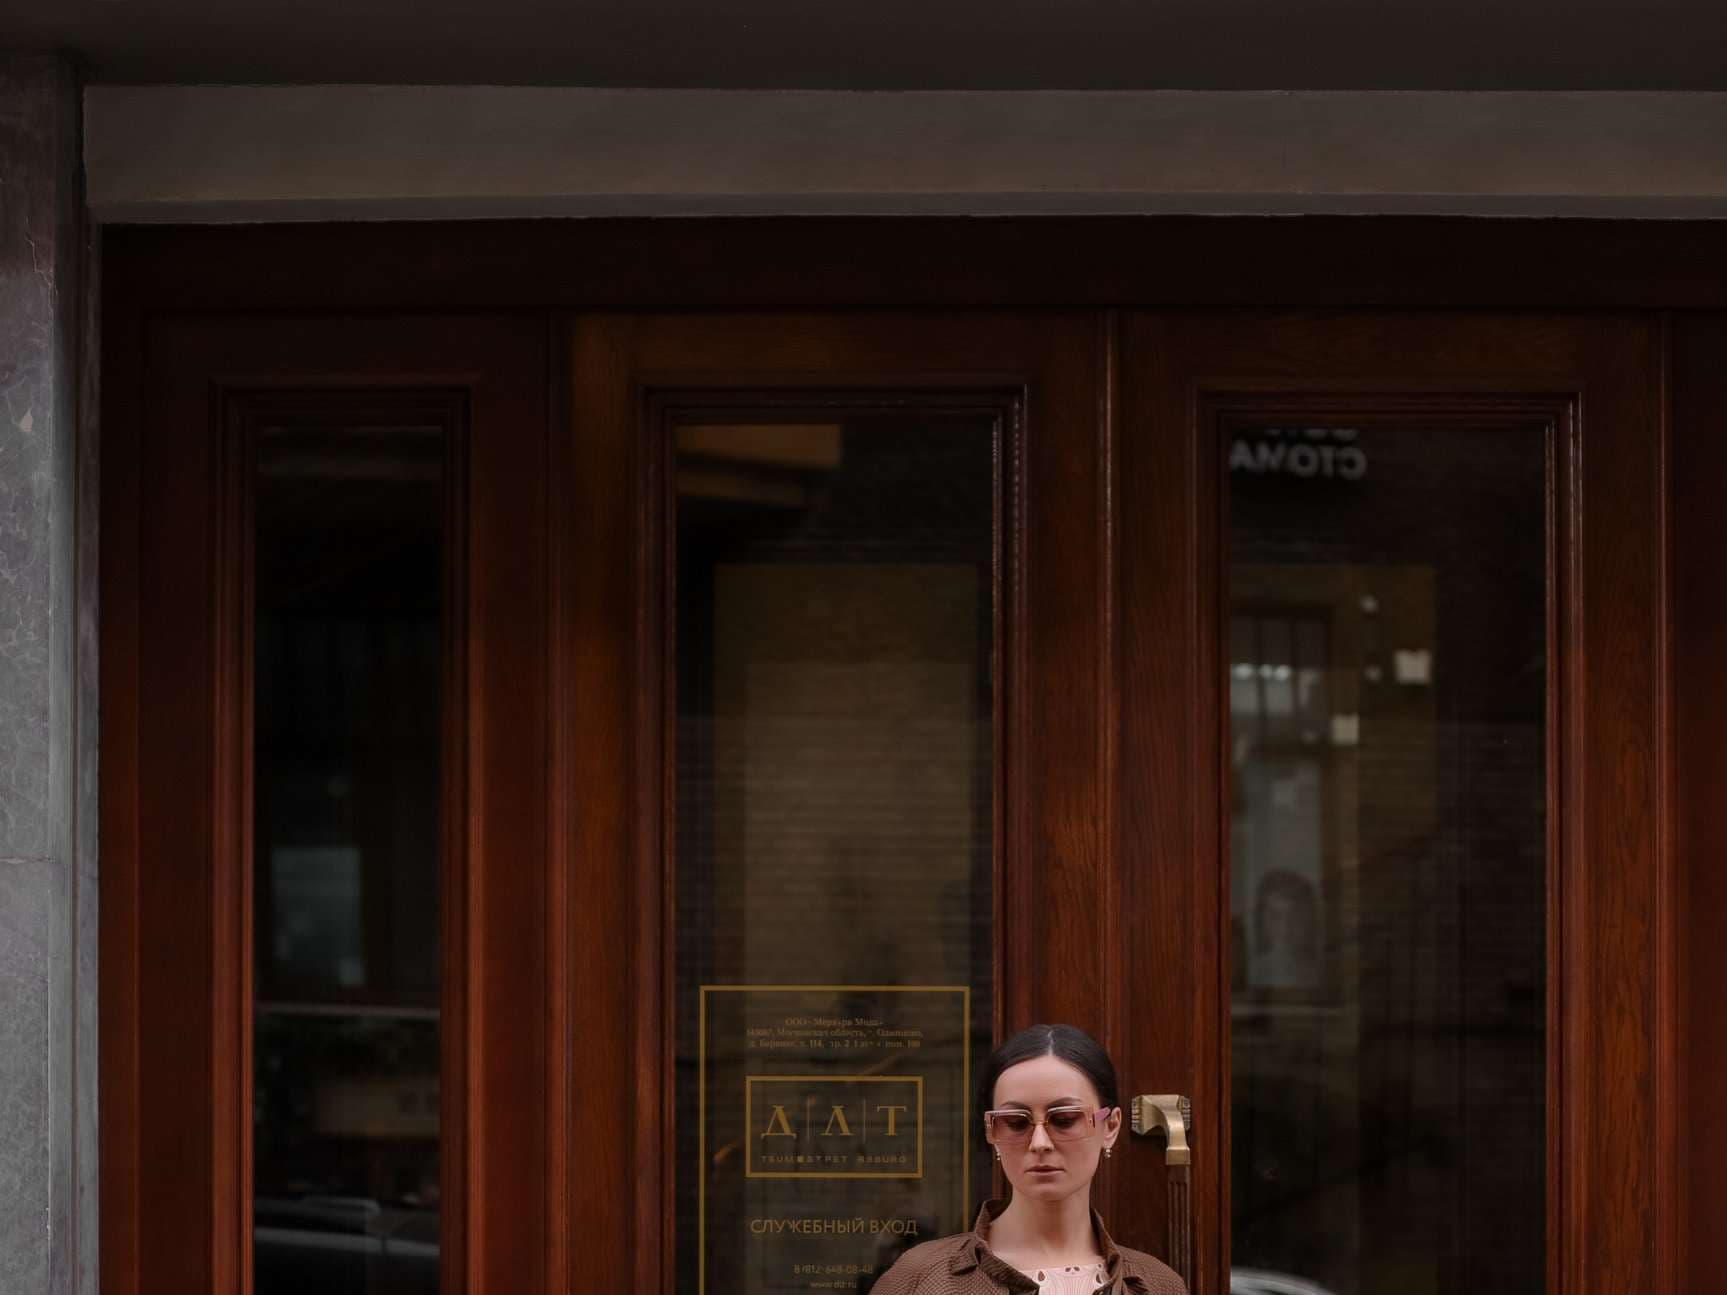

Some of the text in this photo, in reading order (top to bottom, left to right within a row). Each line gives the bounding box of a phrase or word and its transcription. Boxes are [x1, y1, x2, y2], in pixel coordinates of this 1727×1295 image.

[760, 1104, 797, 1139] Д
[750, 1217, 918, 1236] СЛУЖЕБНЫЙ ВХОД
